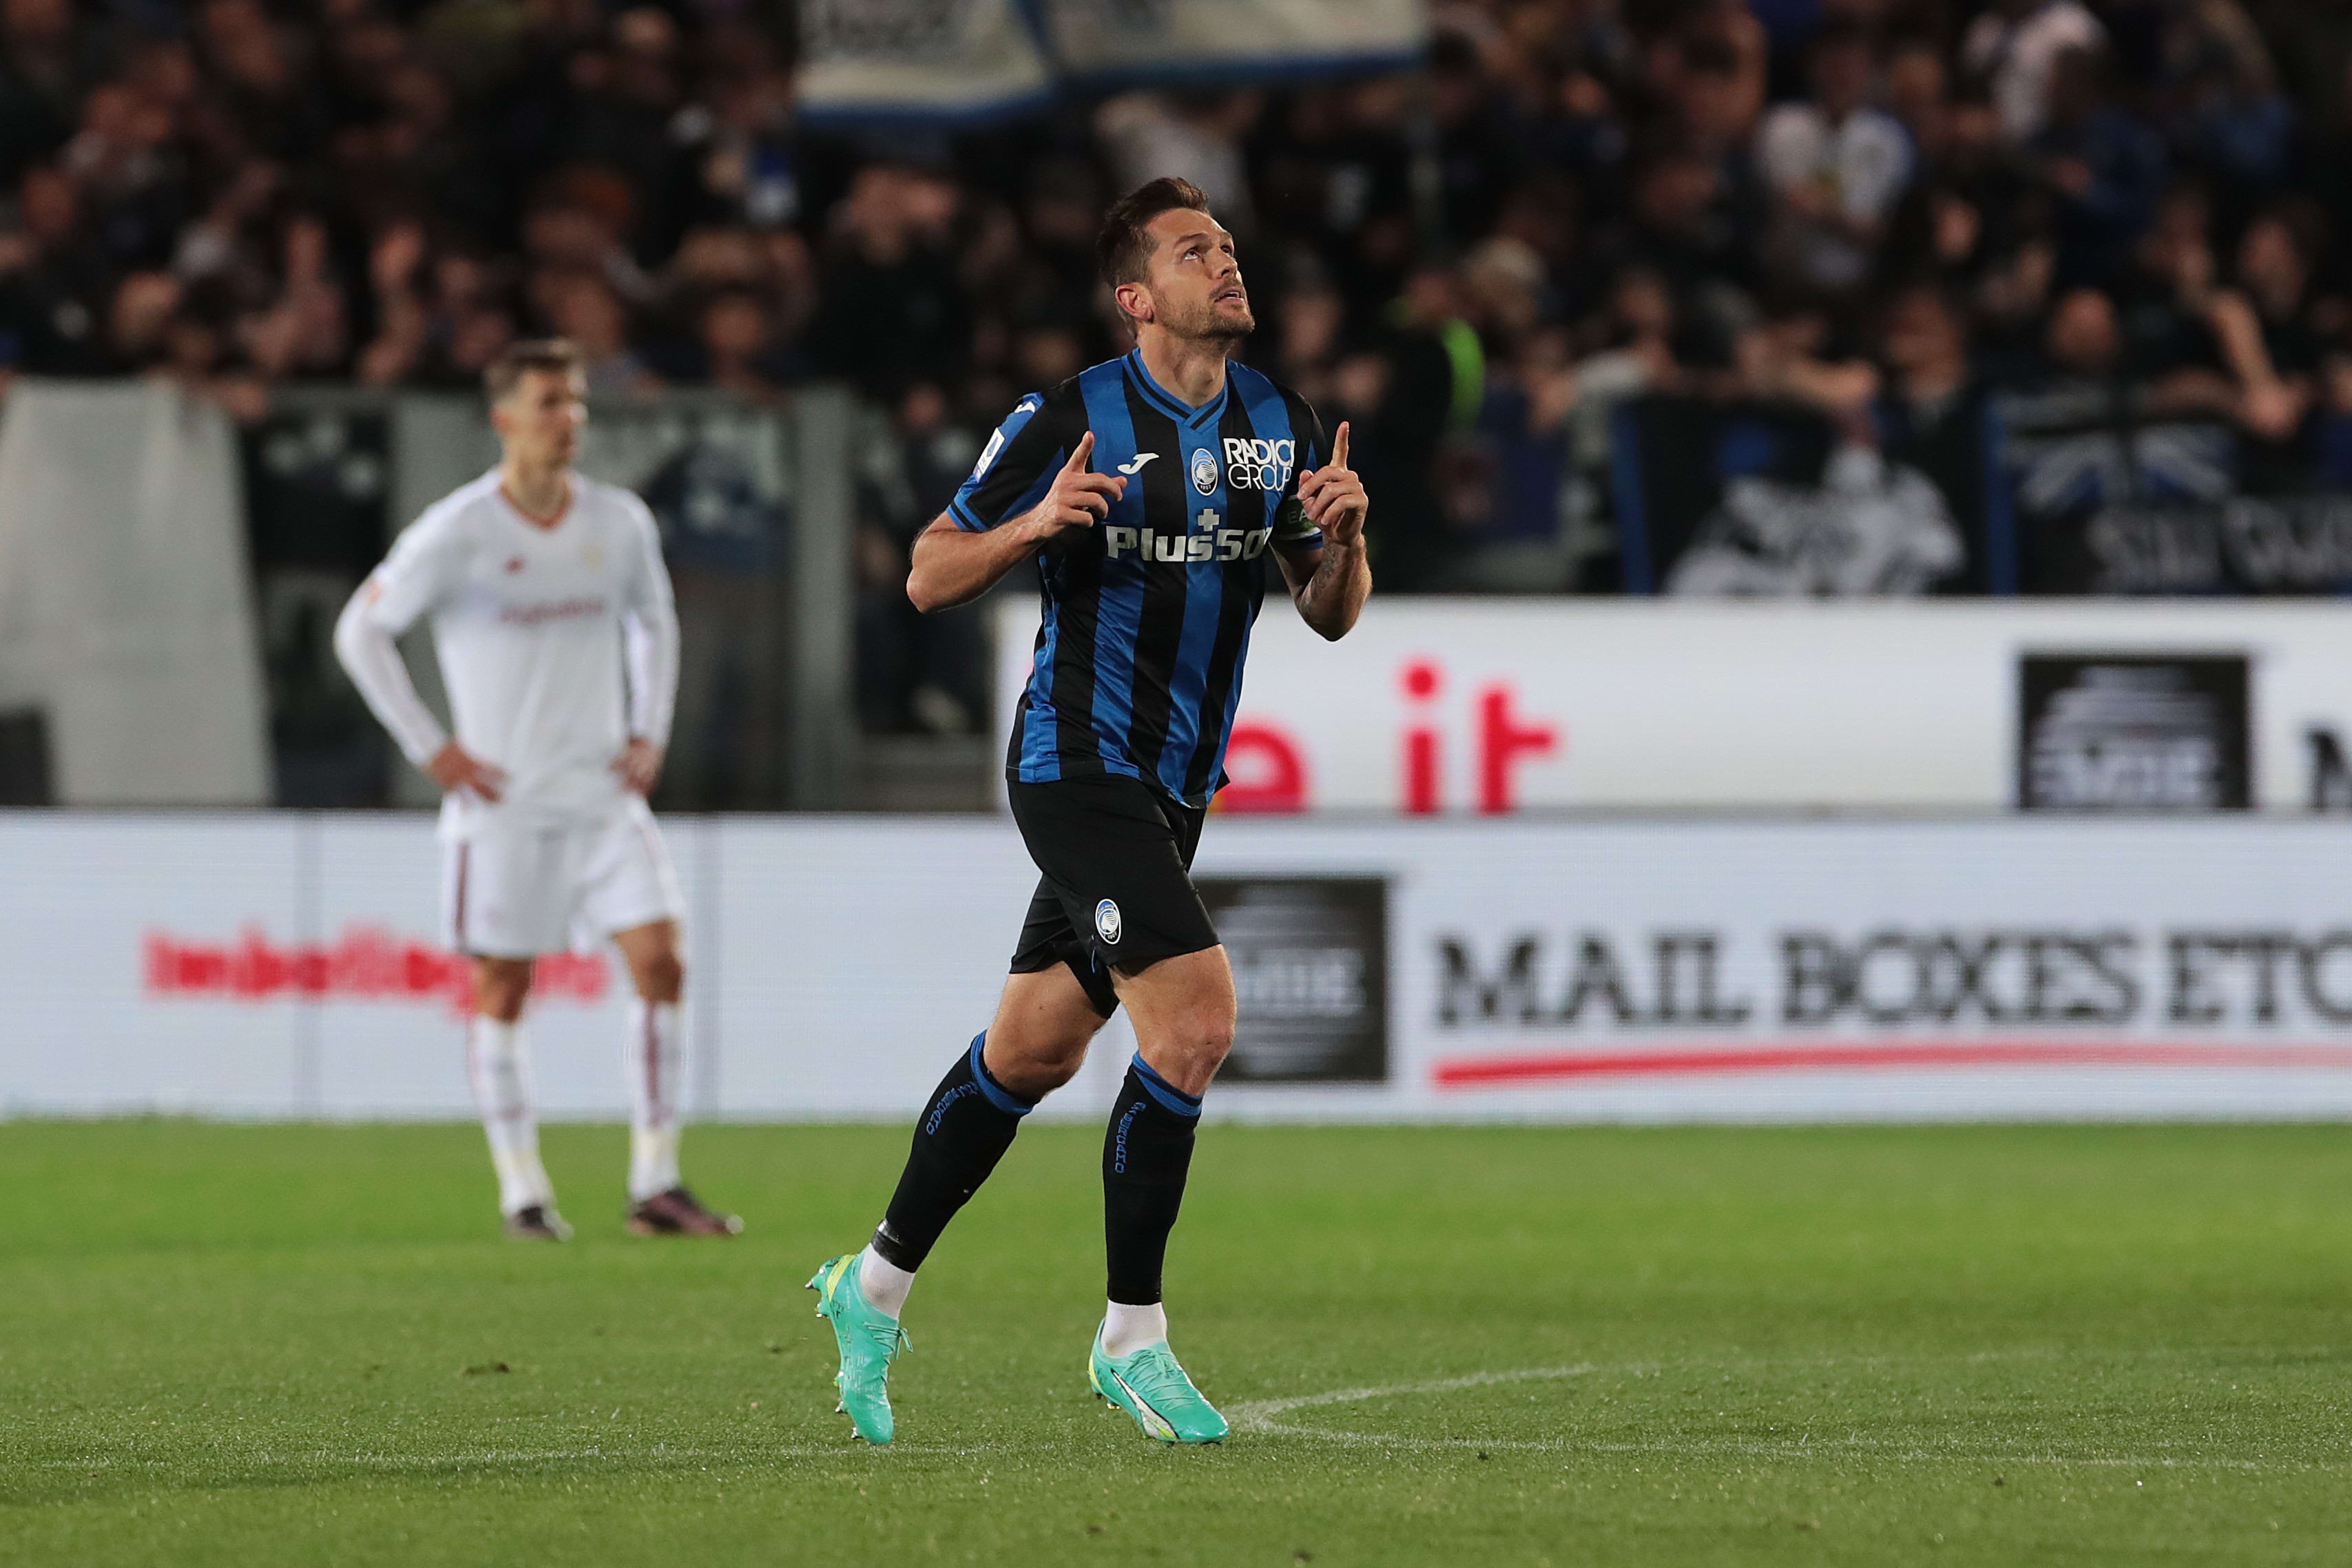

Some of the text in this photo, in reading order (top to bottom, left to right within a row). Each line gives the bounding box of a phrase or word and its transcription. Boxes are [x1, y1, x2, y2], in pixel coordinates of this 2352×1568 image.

[1223, 438, 1295, 467] RADICI
[1228, 463, 1292, 492] GROUP
[1105, 525, 1273, 562] Plus50
[1435, 933, 1755, 1025] MAIL
[1777, 931, 2142, 1025] BOXES
